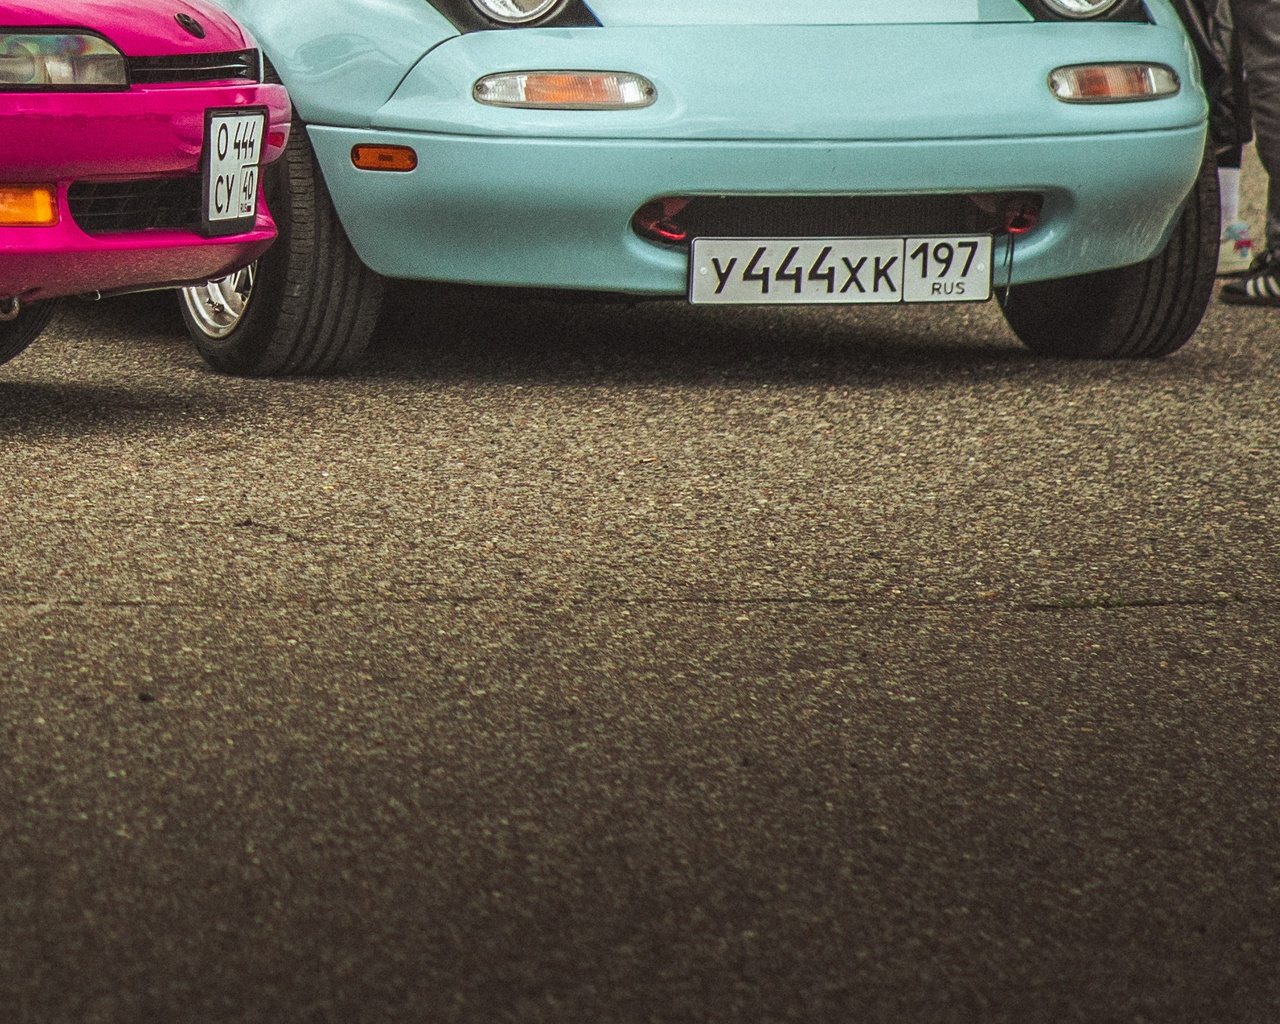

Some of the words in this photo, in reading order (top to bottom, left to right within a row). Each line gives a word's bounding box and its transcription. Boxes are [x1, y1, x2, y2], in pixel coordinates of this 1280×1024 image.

[233, 121, 257, 160] 444
[242, 170, 254, 201] 40
[910, 240, 979, 279] 197
[931, 281, 965, 296] RUS
